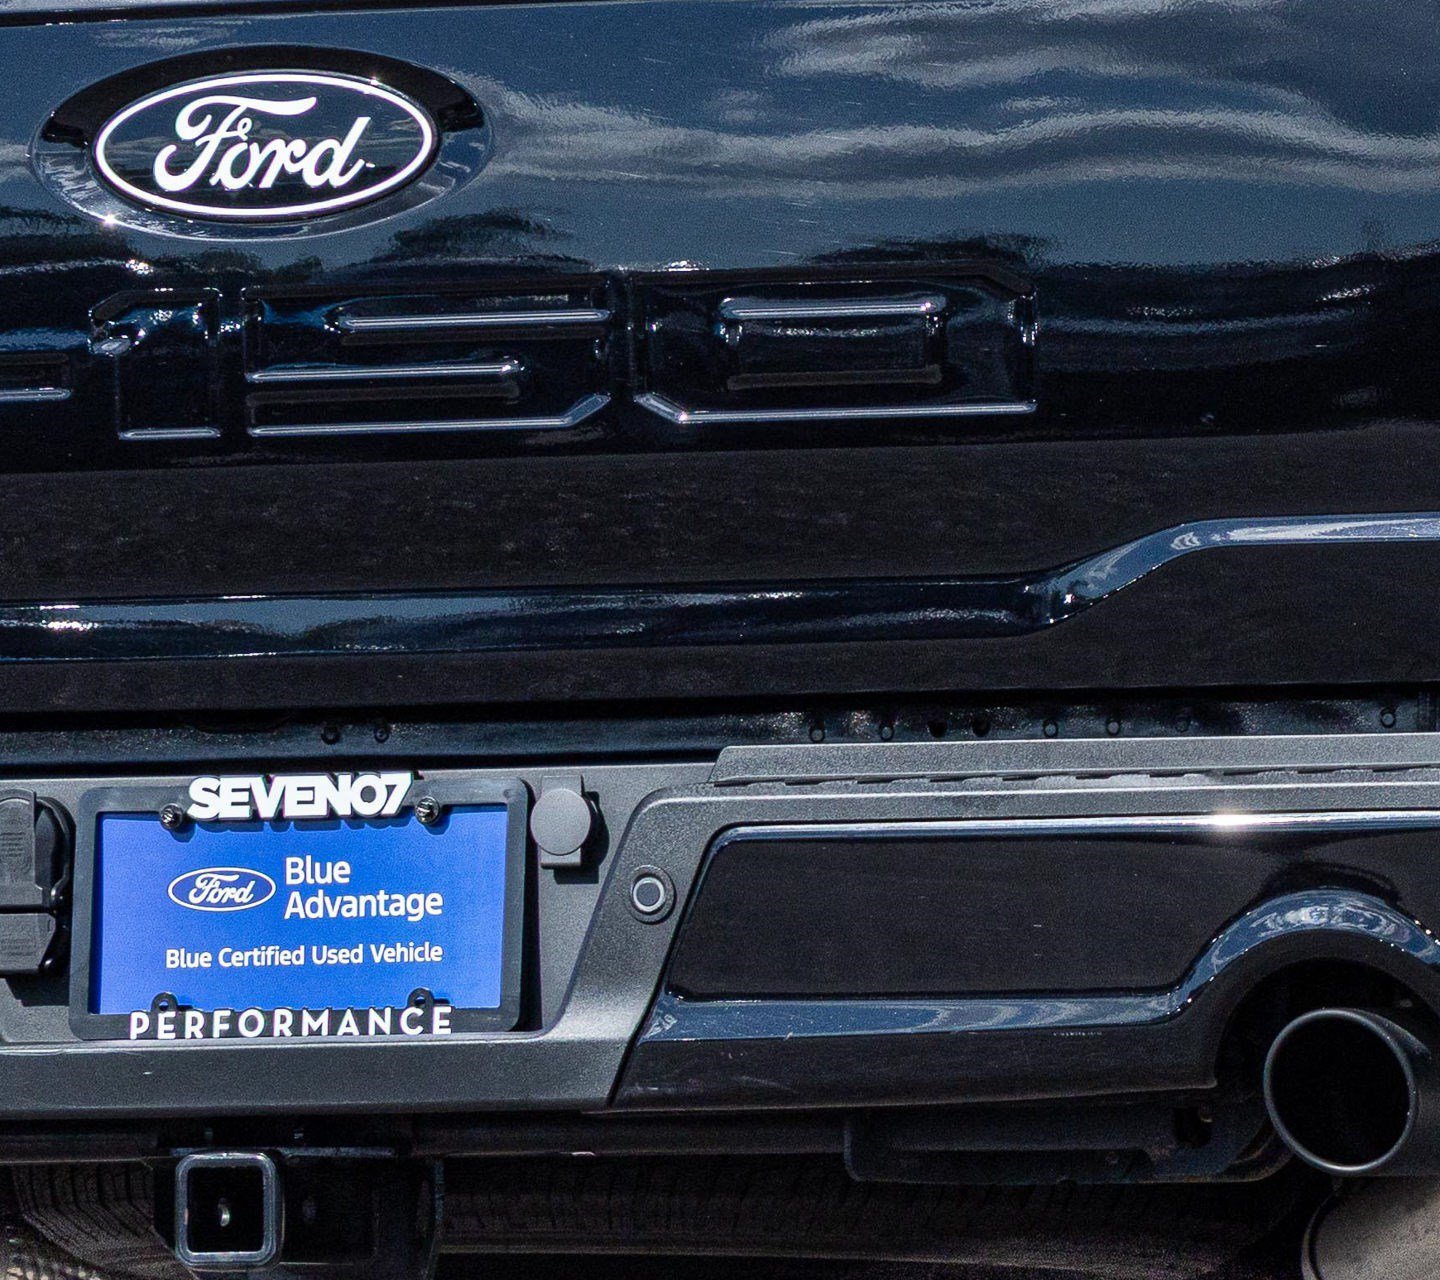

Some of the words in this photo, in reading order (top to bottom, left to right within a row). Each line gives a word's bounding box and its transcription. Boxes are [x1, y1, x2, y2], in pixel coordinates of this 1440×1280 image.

[153, 95, 372, 192] Ford
[285, 855, 351, 885] Blue
[188, 872, 256, 905] Ford
[284, 889, 443, 922] Advantage
[166, 949, 212, 969] Blue
[218, 945, 305, 968] Certified
[311, 943, 364, 965] Used
[370, 941, 443, 963] Vehicle
[129, 1006, 452, 1040] PERFORMANCE
